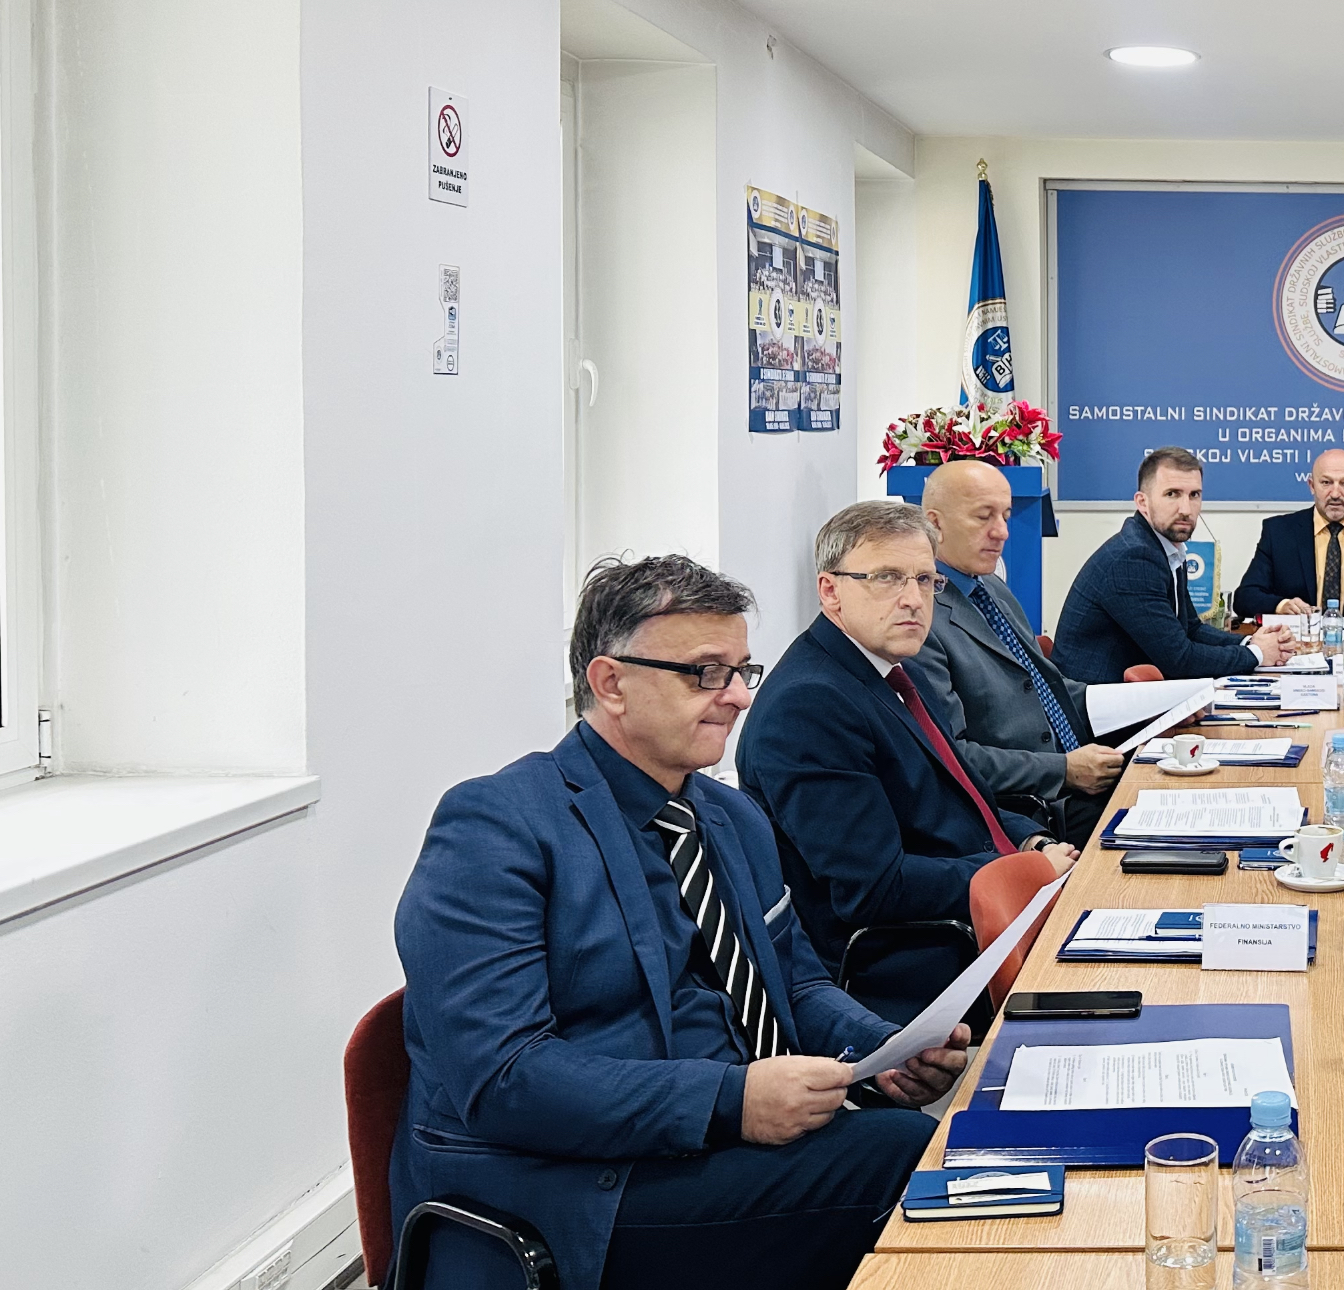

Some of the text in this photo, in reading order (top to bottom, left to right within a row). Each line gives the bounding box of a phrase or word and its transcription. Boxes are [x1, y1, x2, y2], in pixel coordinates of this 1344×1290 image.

[432, 164, 467, 181] ZABRANJENO
[438, 180, 462, 194] PUŠENJE
[1287, 248, 1316, 294] DRŽAVNIH
[1299, 266, 1319, 307] SUDSKOJ
[1286, 297, 1302, 342] SINDIKAT
[1068, 405, 1185, 421] SAMOSTALNI
[1193, 406, 1277, 422] SINDIKAT
[1218, 428, 1230, 443] U
[1237, 428, 1336, 443] ORGANIMA
[1238, 449, 1299, 463] VLASTI
[1306, 450, 1311, 463] I
[1210, 922, 1251, 930] FEDERALNO
